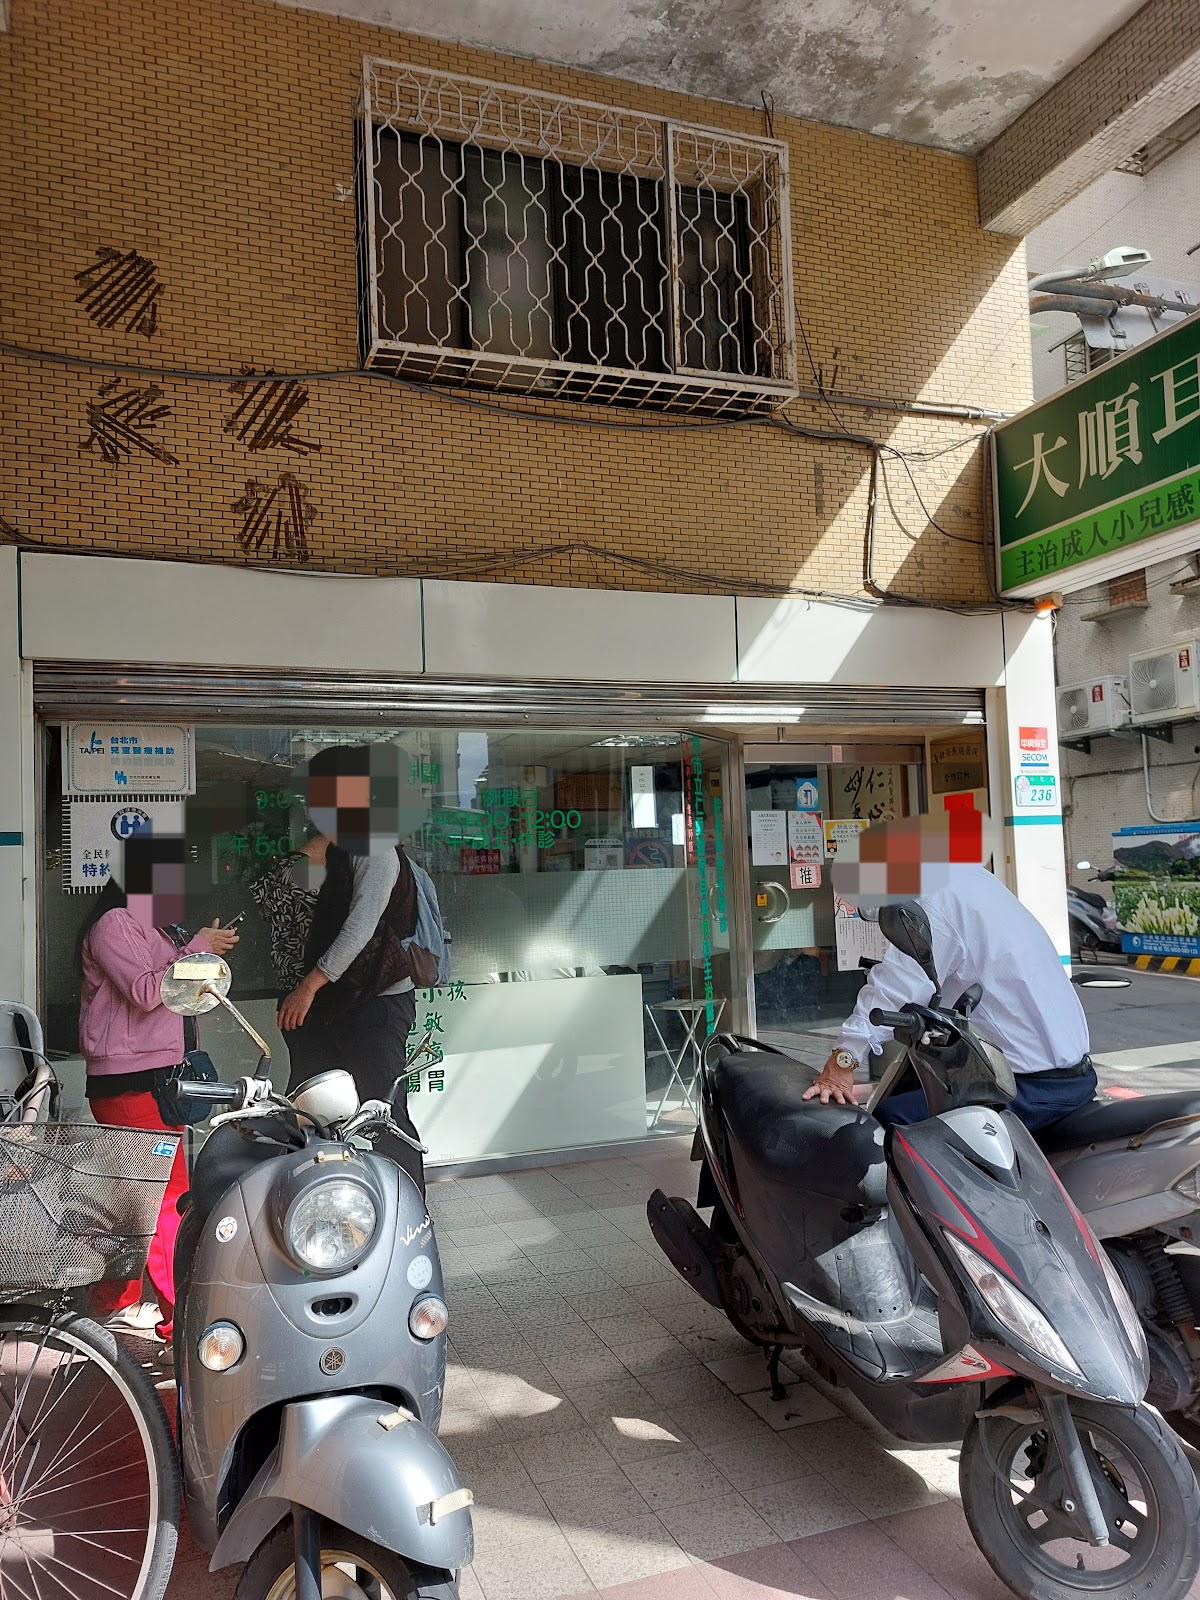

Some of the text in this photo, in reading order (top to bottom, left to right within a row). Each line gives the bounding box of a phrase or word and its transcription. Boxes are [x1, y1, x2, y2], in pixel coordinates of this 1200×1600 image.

[1015, 478, 1200, 580] 主治成人小兒感
[110, 736, 138, 745] 台北市
[1021, 753, 1048, 762] SECOM
[481, 788, 539, 808] 例假日
[1030, 789, 1052, 802] 236
[800, 866, 813, 885] 推
[415, 980, 467, 1003] 小孩
